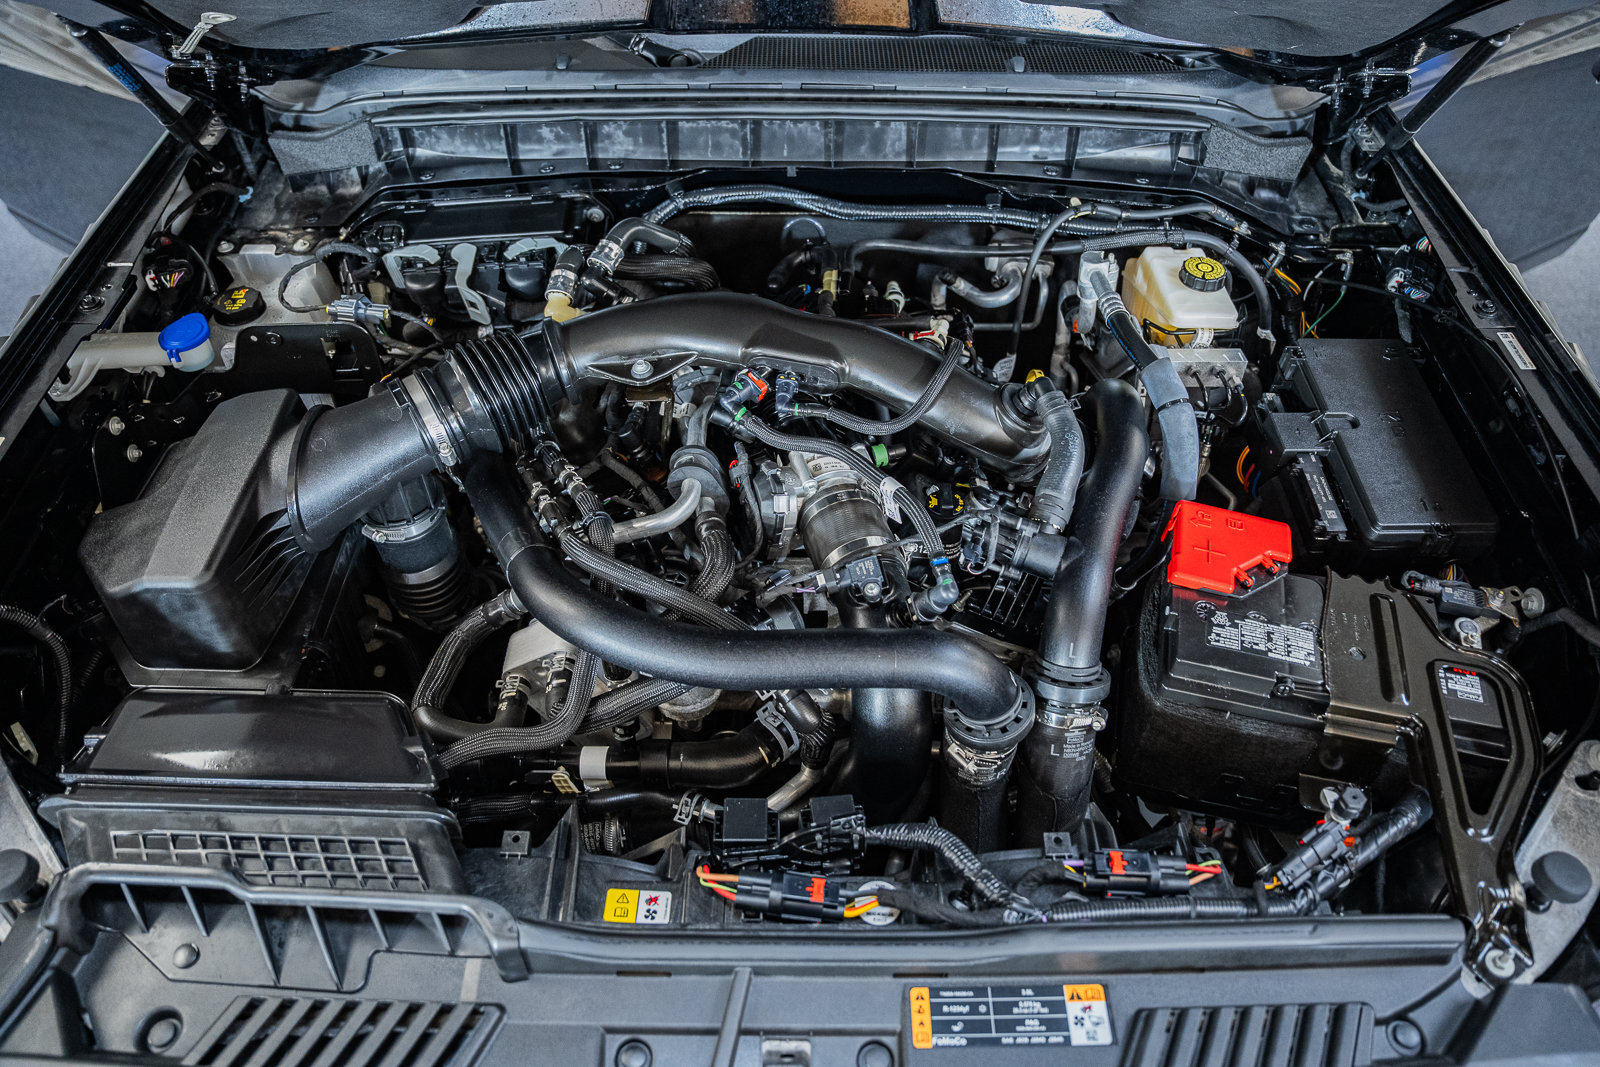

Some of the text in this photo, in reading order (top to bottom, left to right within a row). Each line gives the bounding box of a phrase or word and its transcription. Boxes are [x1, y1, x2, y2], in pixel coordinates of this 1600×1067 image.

[1069, 642, 1076, 659] L
[1051, 744, 1060, 756] L
[932, 1036, 968, 1047] FoMoCo
